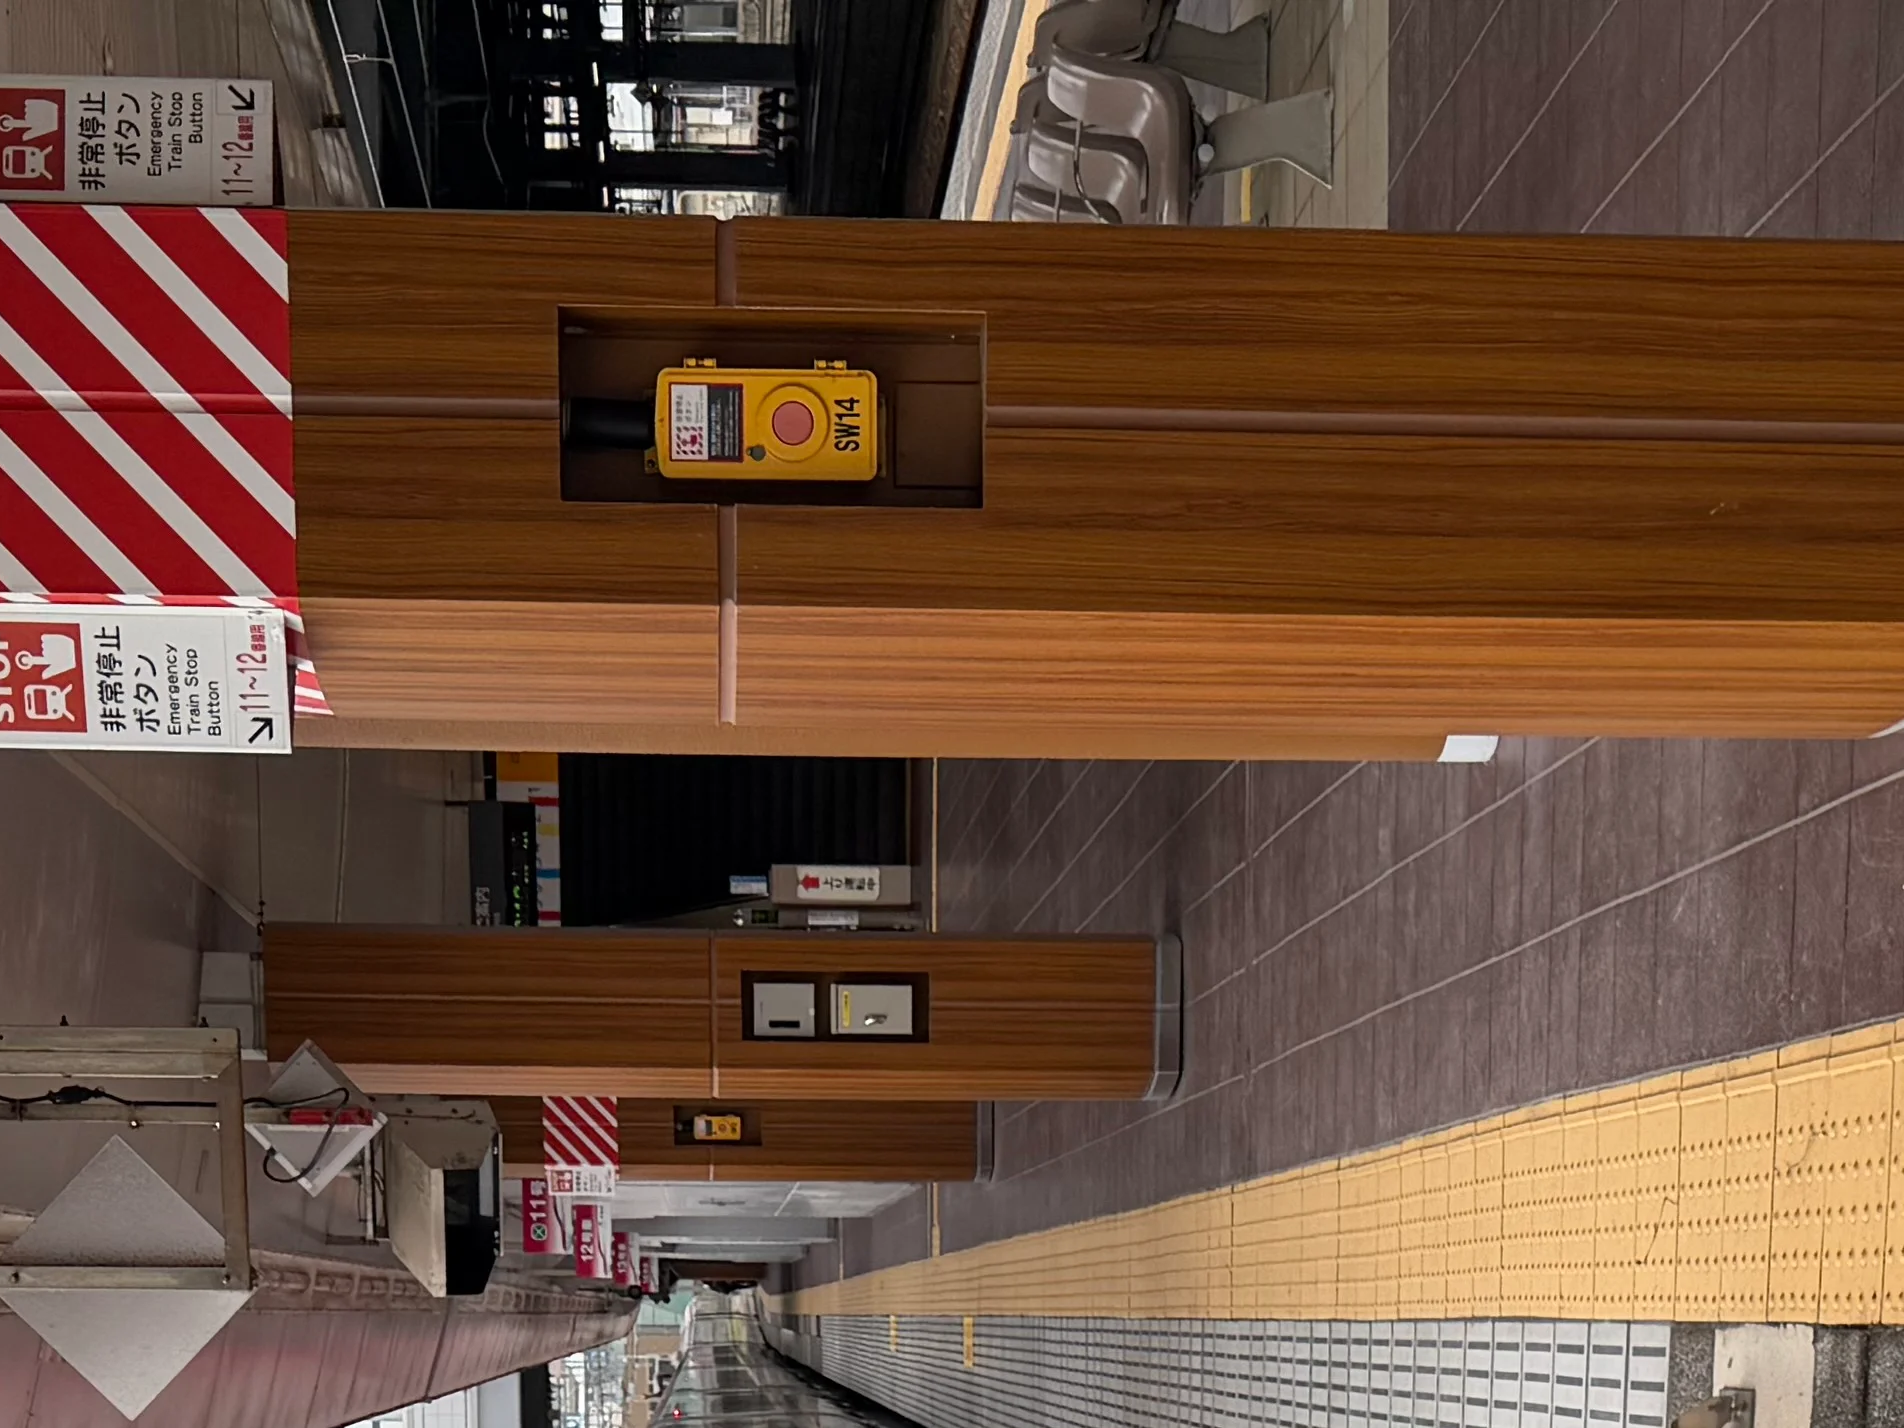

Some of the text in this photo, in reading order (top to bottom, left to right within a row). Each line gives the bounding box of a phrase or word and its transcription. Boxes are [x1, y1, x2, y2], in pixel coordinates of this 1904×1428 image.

[77, 90, 106, 191] 非常停止
[112, 92, 141, 166] ボタン
[147, 91, 163, 177] Emergency
[167, 91, 183, 172] Train Stop
[188, 92, 203, 144] Button
[833, 397, 861, 453] SW14
[93, 625, 127, 732] 非常停止
[132, 654, 161, 733] ボタン
[165, 643, 182, 736] Emergency
[184, 648, 202, 735] Train Stop
[207, 680, 222, 737] Button
